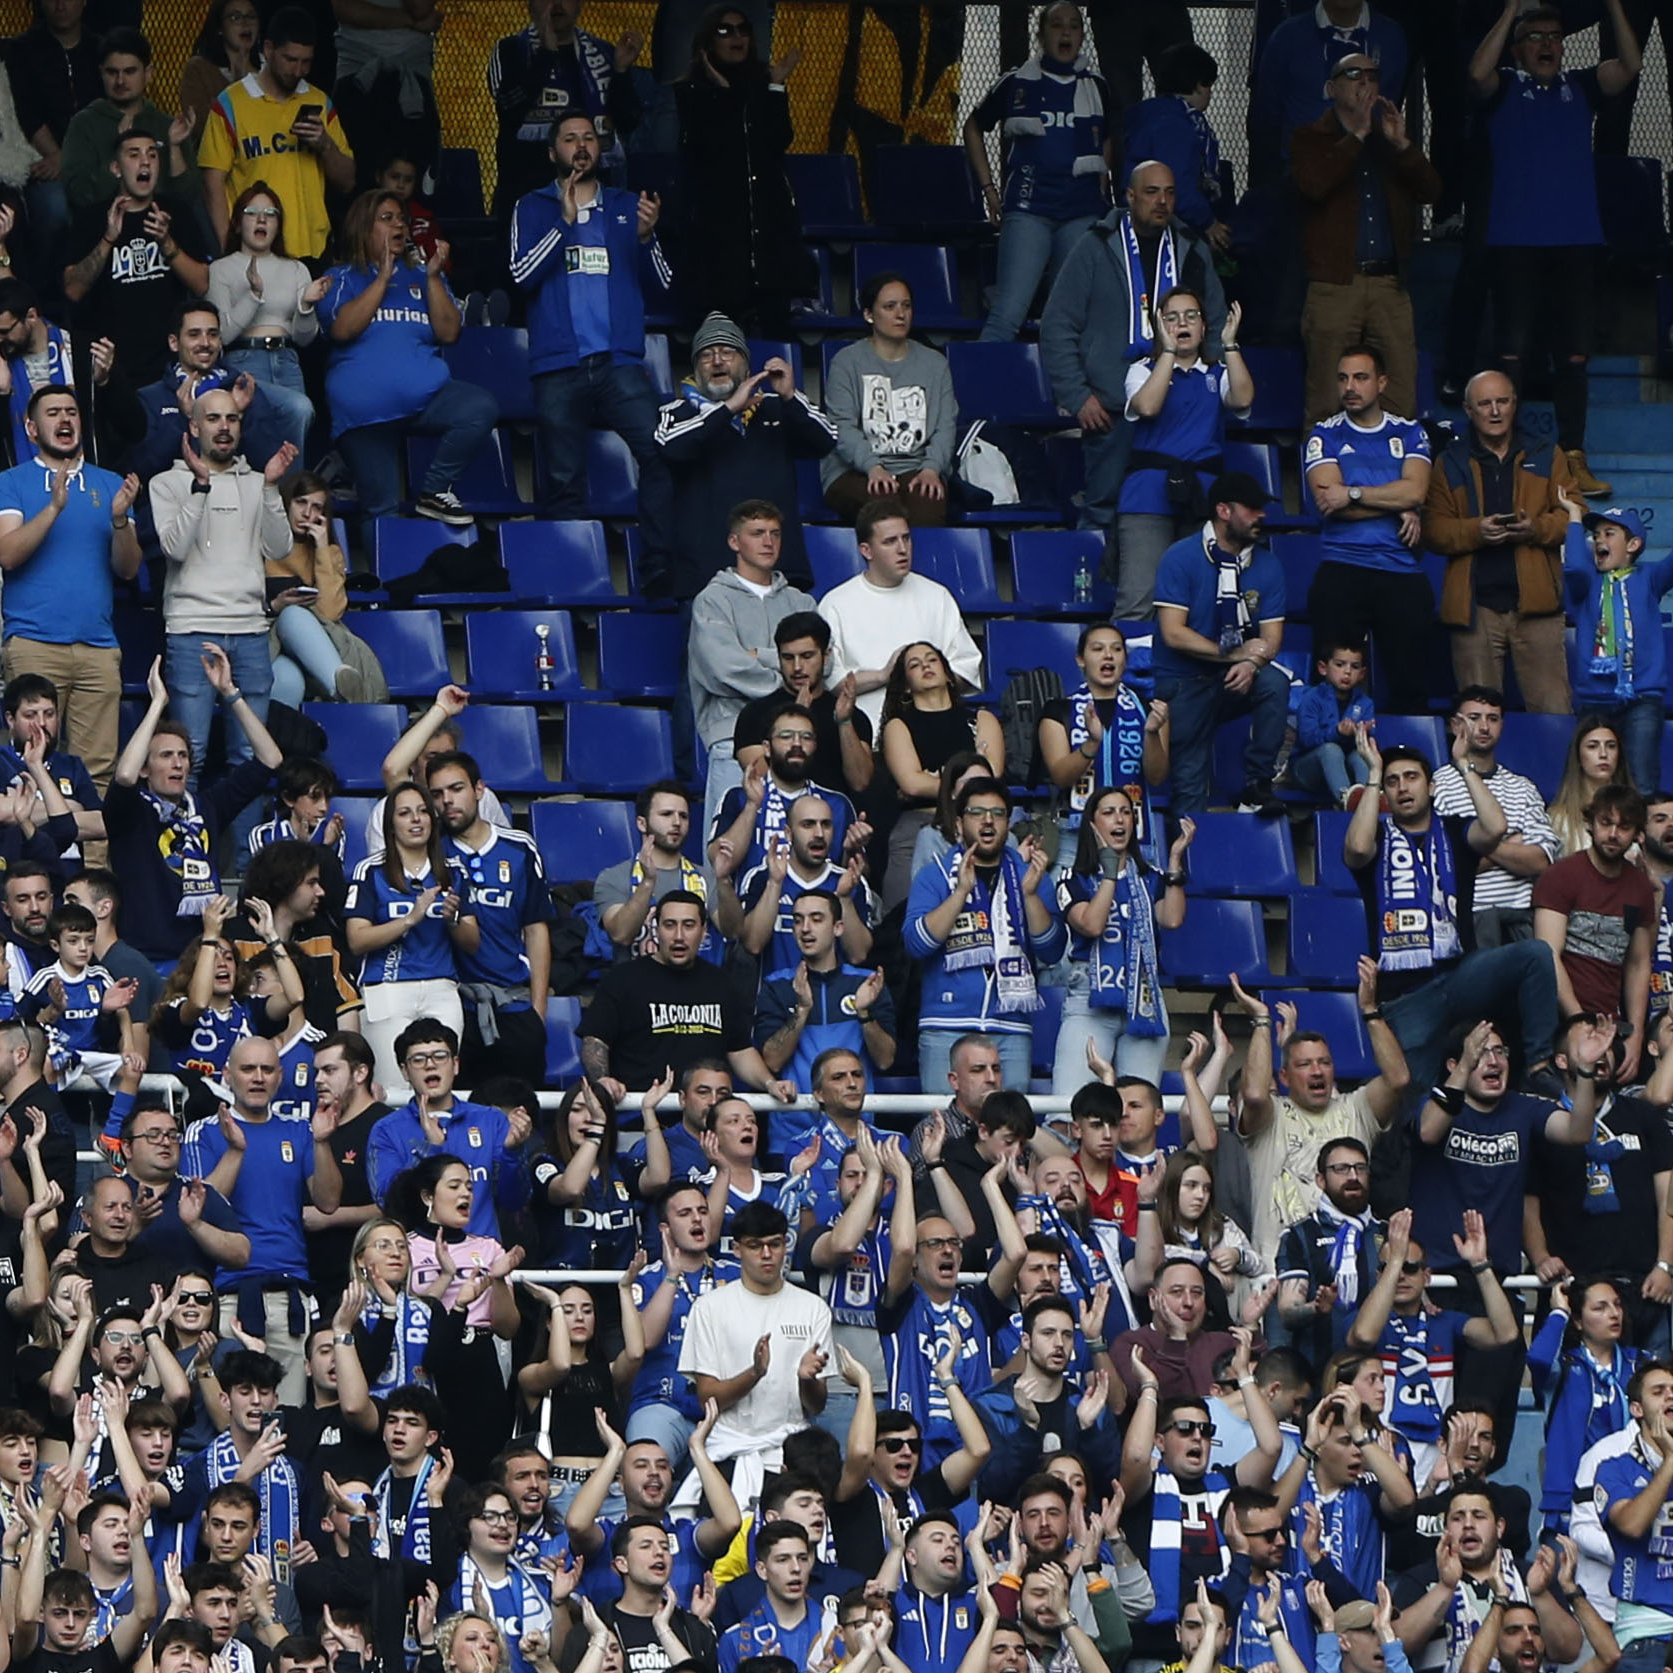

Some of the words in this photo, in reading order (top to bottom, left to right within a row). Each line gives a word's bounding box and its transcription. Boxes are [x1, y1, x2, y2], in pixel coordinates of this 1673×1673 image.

[65, 1009, 100, 1020] DIGI
[648, 1002, 724, 1029] LACOLONIA
[565, 1208, 636, 1230] DIGI
